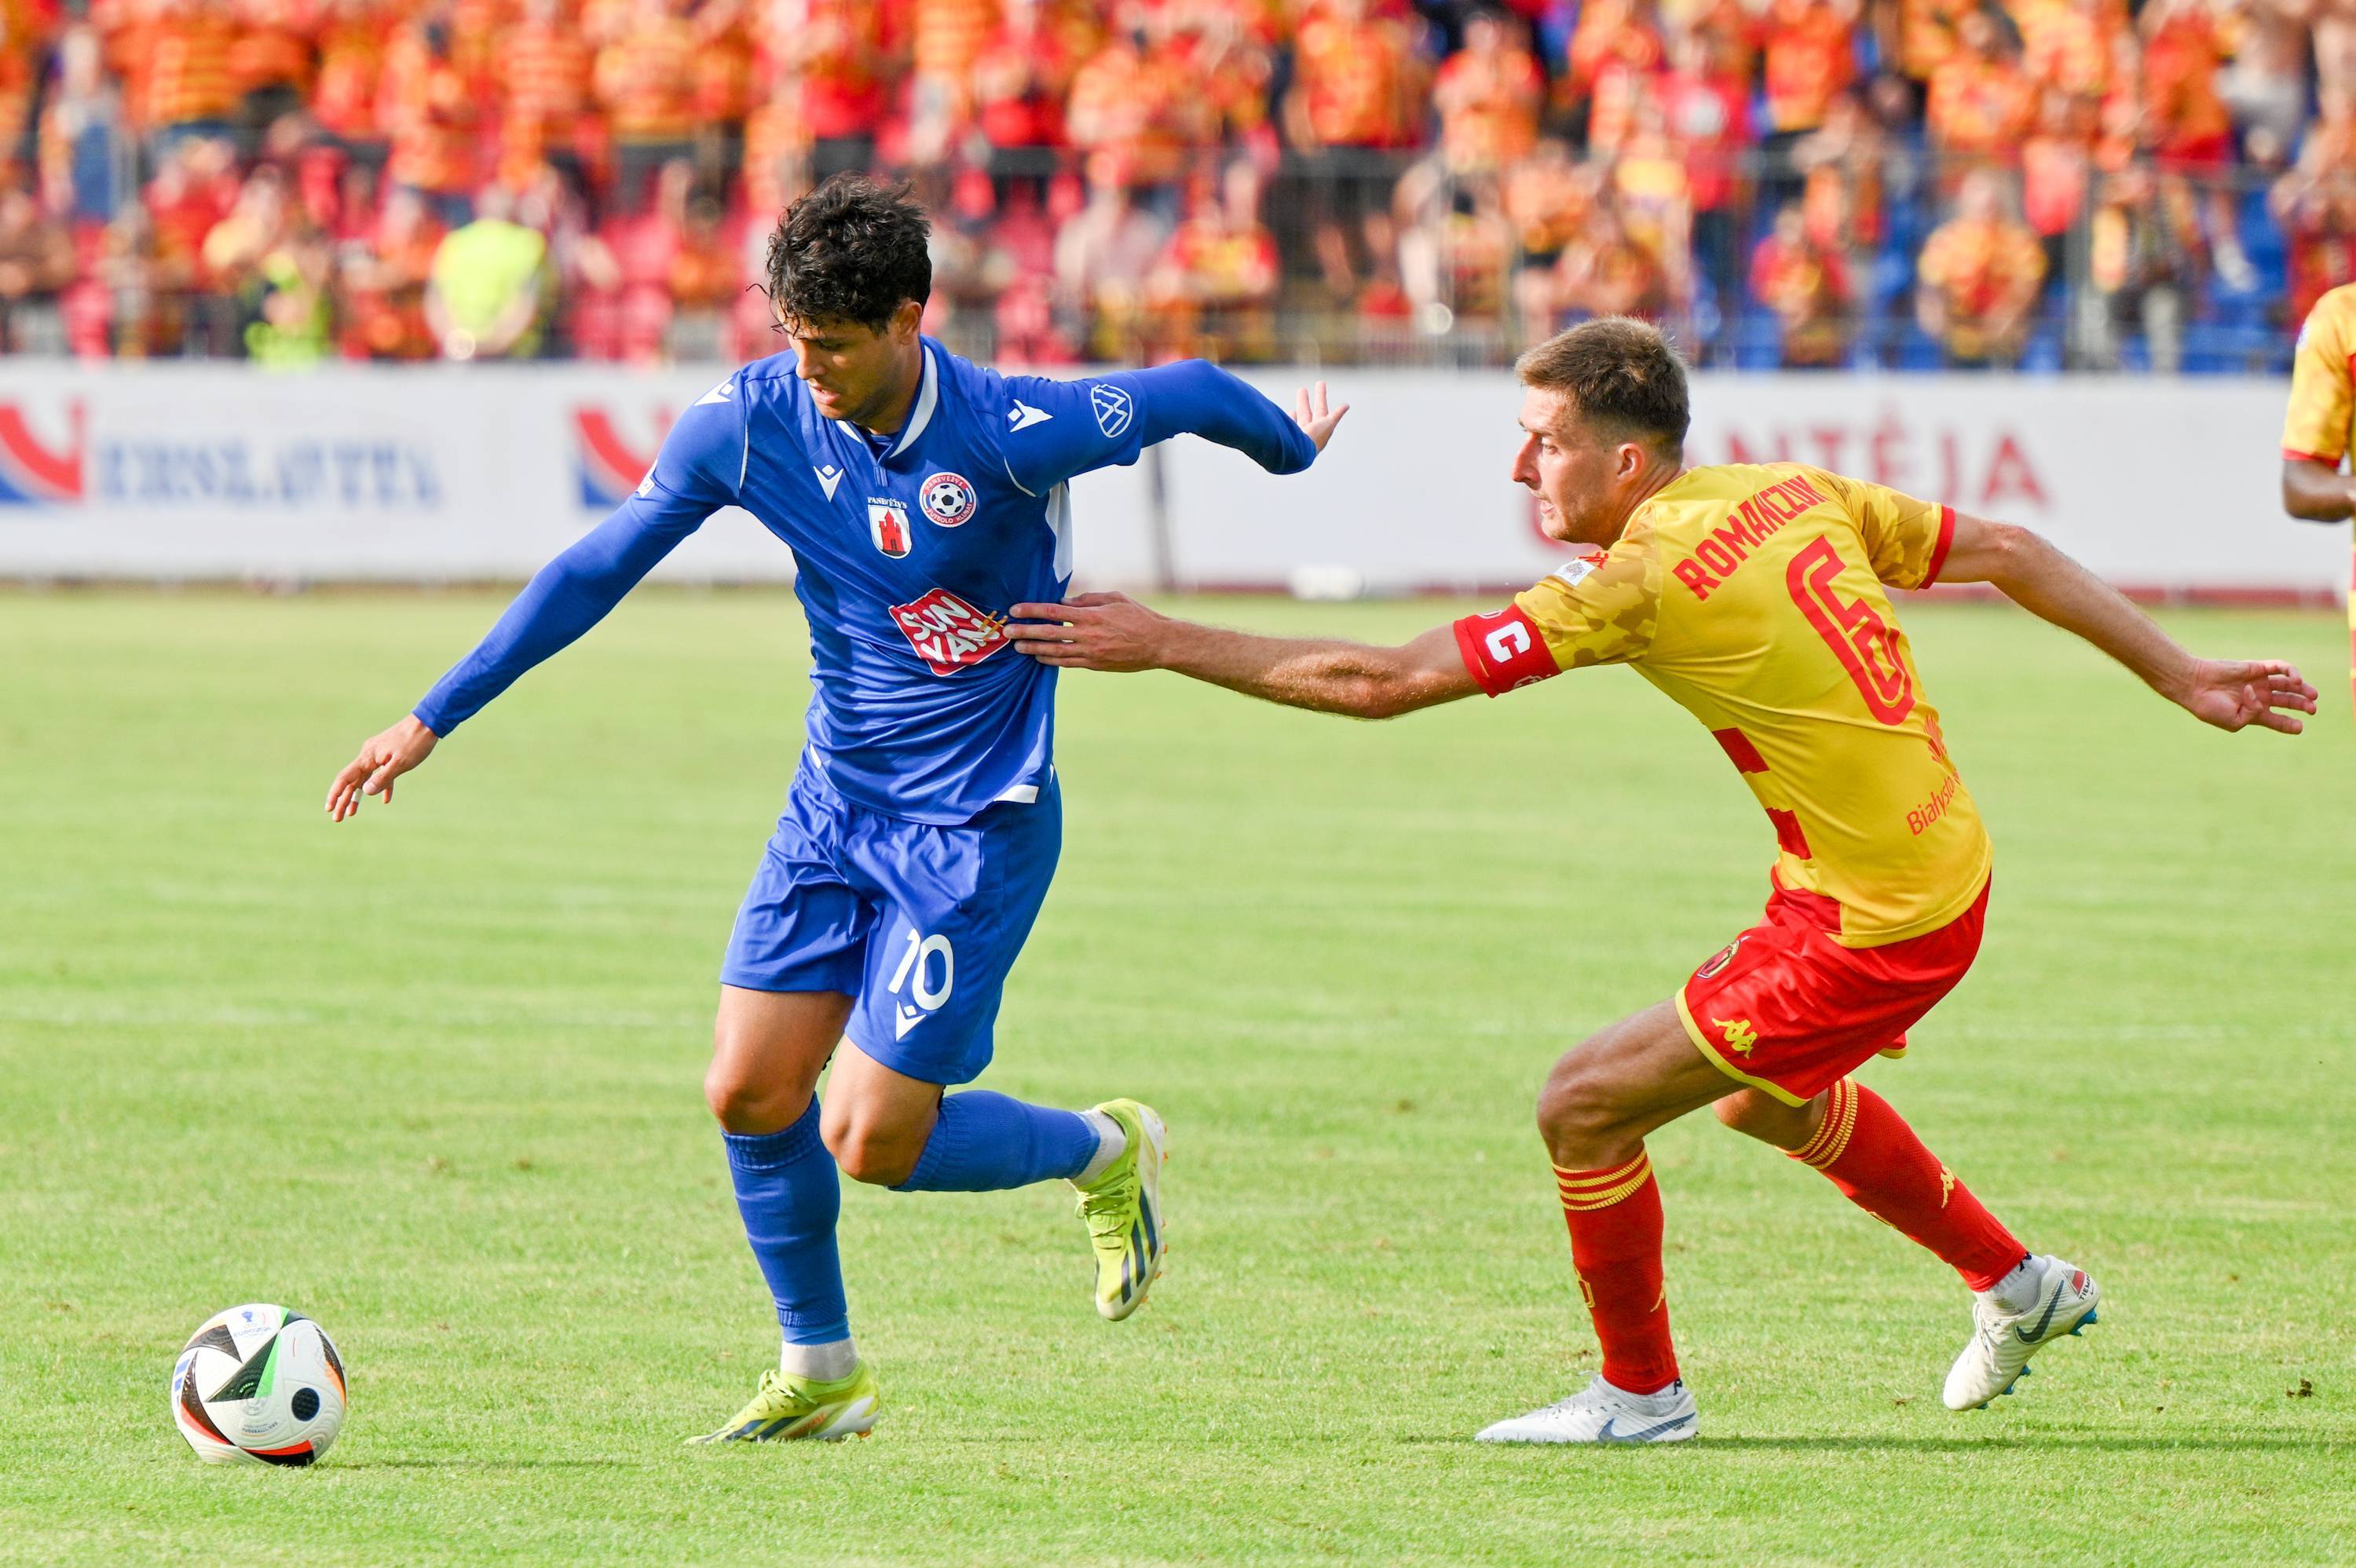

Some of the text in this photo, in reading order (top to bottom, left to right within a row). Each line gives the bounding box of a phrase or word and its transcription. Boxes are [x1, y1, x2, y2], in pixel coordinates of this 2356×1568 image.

[927, 508, 954, 524] FUTBOLO
[1672, 475, 1828, 601] ROMANCZUK
[899, 596, 971, 641] SUN
[1485, 620, 1531, 663] C
[1786, 534, 1915, 726] 6
[1907, 773, 1958, 836] Białysto
[888, 928, 953, 1011] 10
